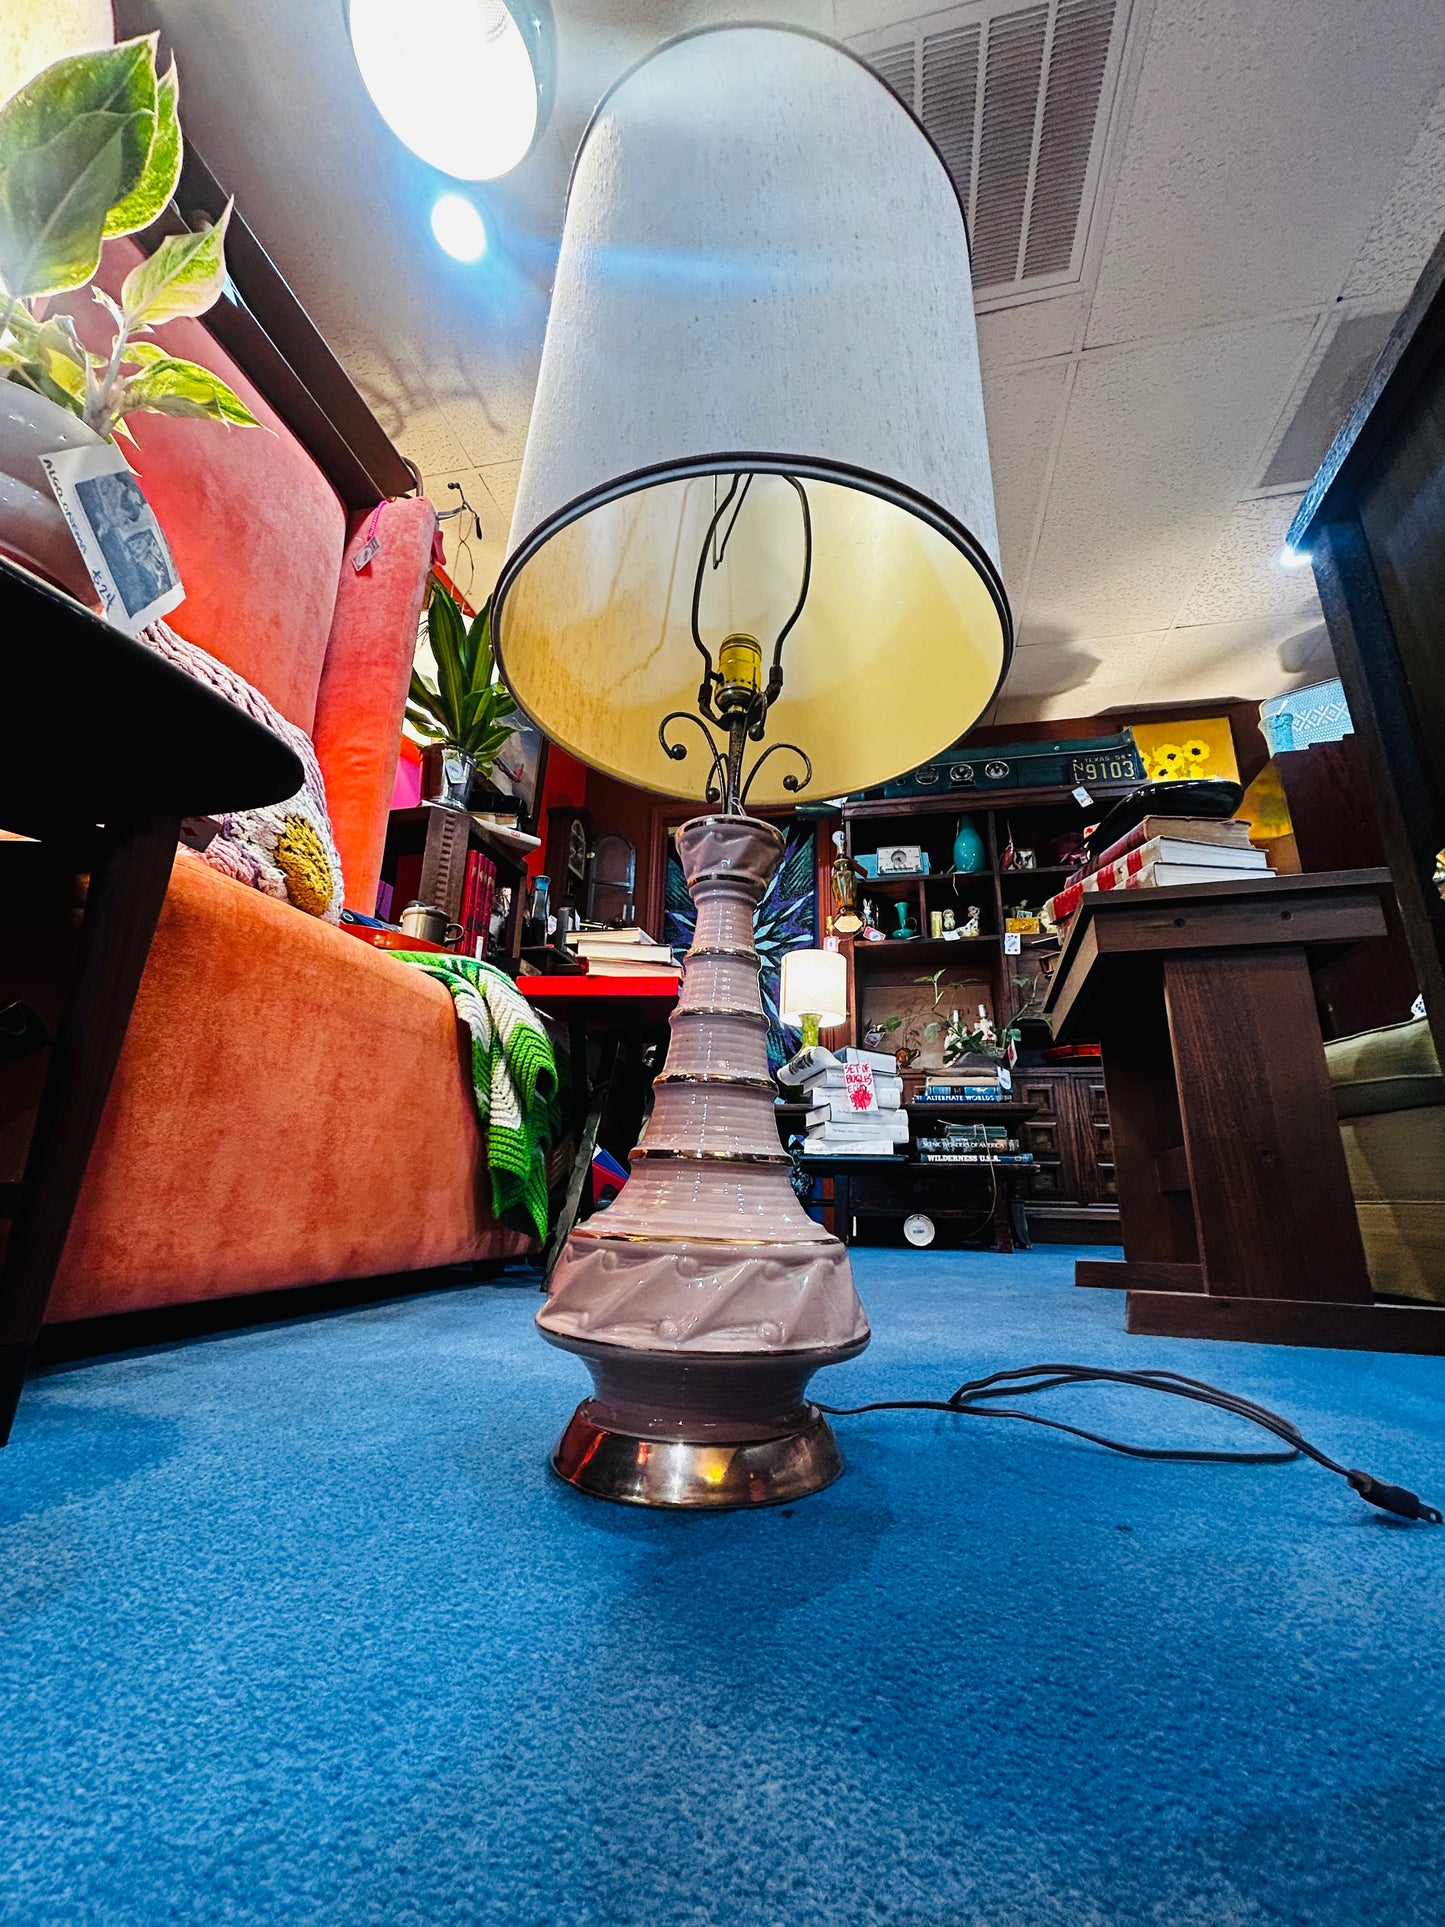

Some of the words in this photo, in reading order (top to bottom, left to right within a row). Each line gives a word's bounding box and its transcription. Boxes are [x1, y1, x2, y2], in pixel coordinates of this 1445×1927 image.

[1085, 755, 1110, 763] TEXAS
[1086, 760, 1135, 780] 9103
[845, 1063, 860, 1073] SET
[862, 1063, 869, 1073] OF
